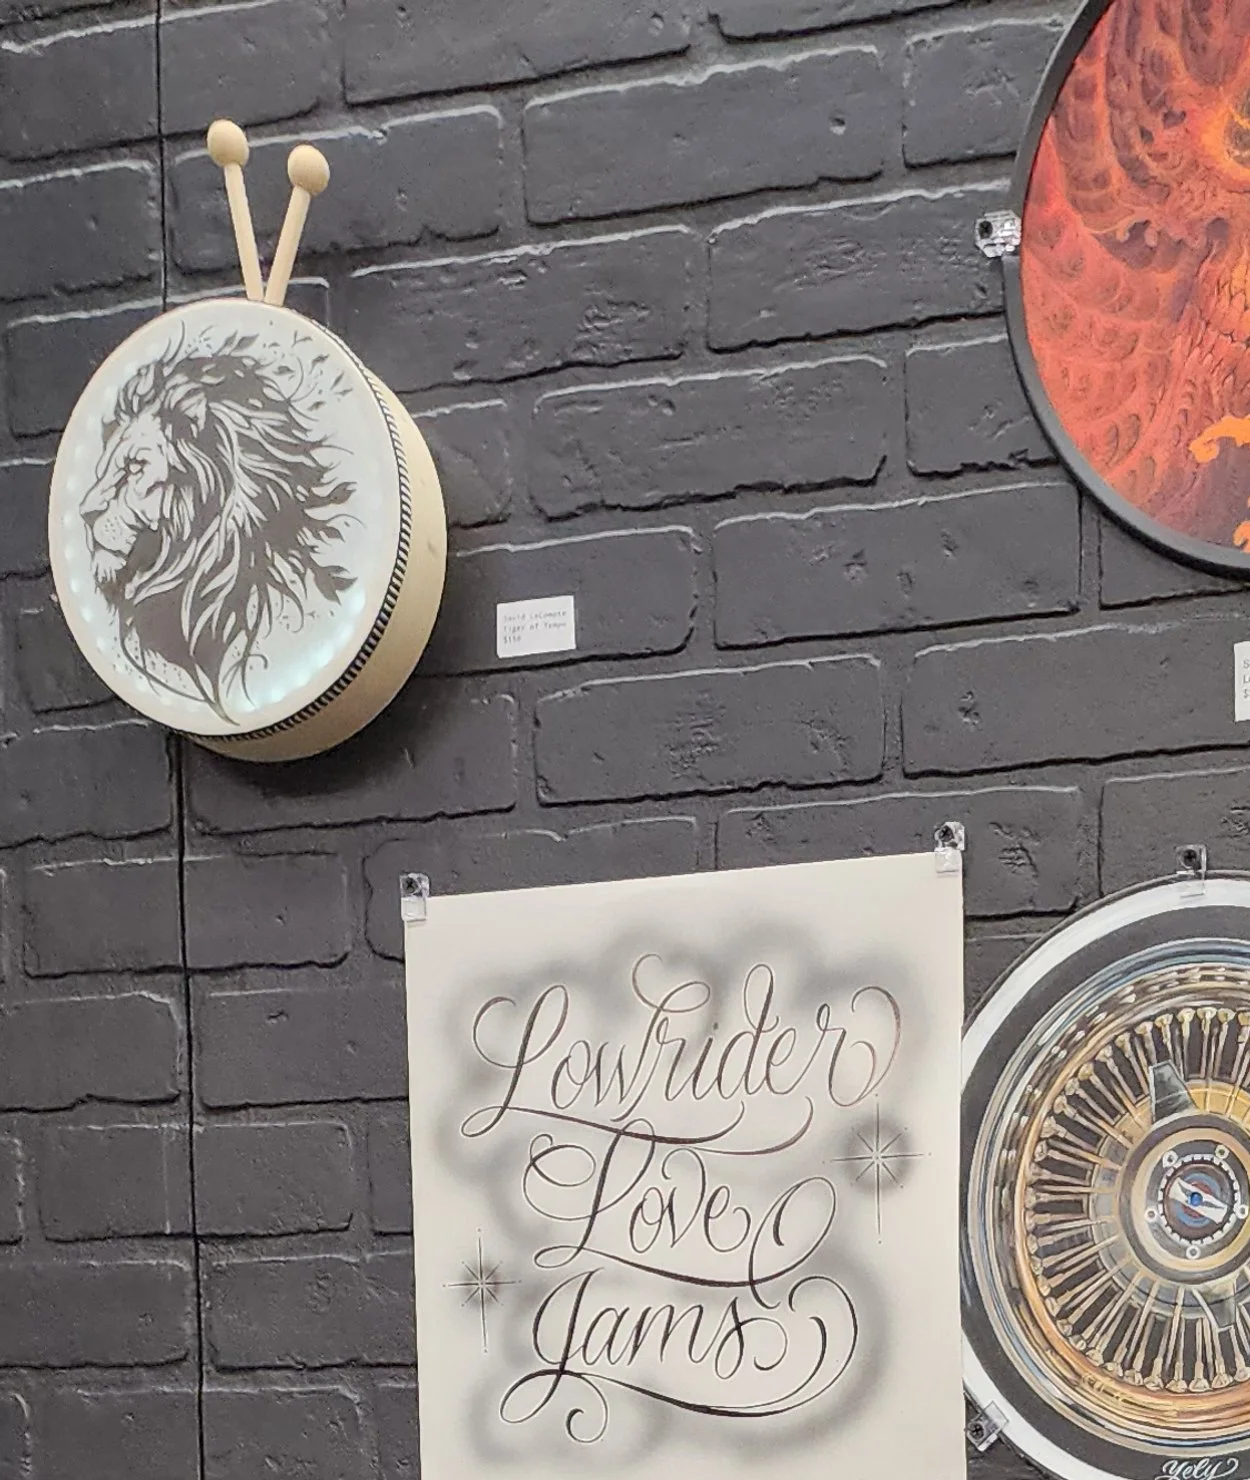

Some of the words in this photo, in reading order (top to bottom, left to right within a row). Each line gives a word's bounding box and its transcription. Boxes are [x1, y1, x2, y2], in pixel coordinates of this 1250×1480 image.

[460, 953, 900, 1155] Lowrider
[522, 1118, 836, 1308] Love
[499, 1267, 858, 1443] Jams
